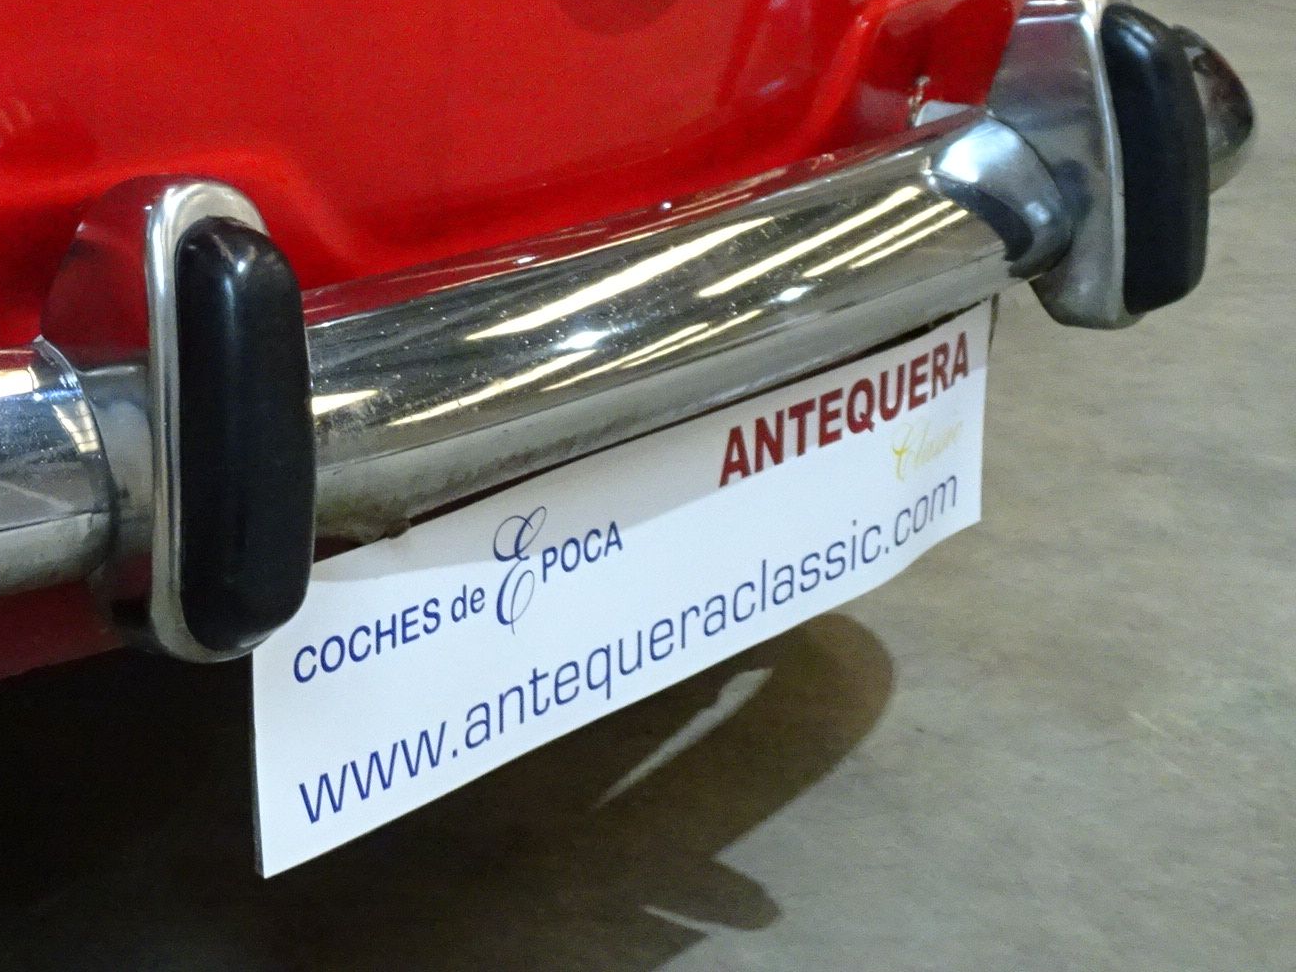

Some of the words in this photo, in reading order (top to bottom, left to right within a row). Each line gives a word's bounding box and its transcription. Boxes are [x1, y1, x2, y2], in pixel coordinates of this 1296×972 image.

[719, 331, 969, 487] ANTEQUERA
[293, 597, 442, 683] COCHES
[451, 585, 486, 623] de
[299, 475, 958, 824] www.antequeraclassic.com
